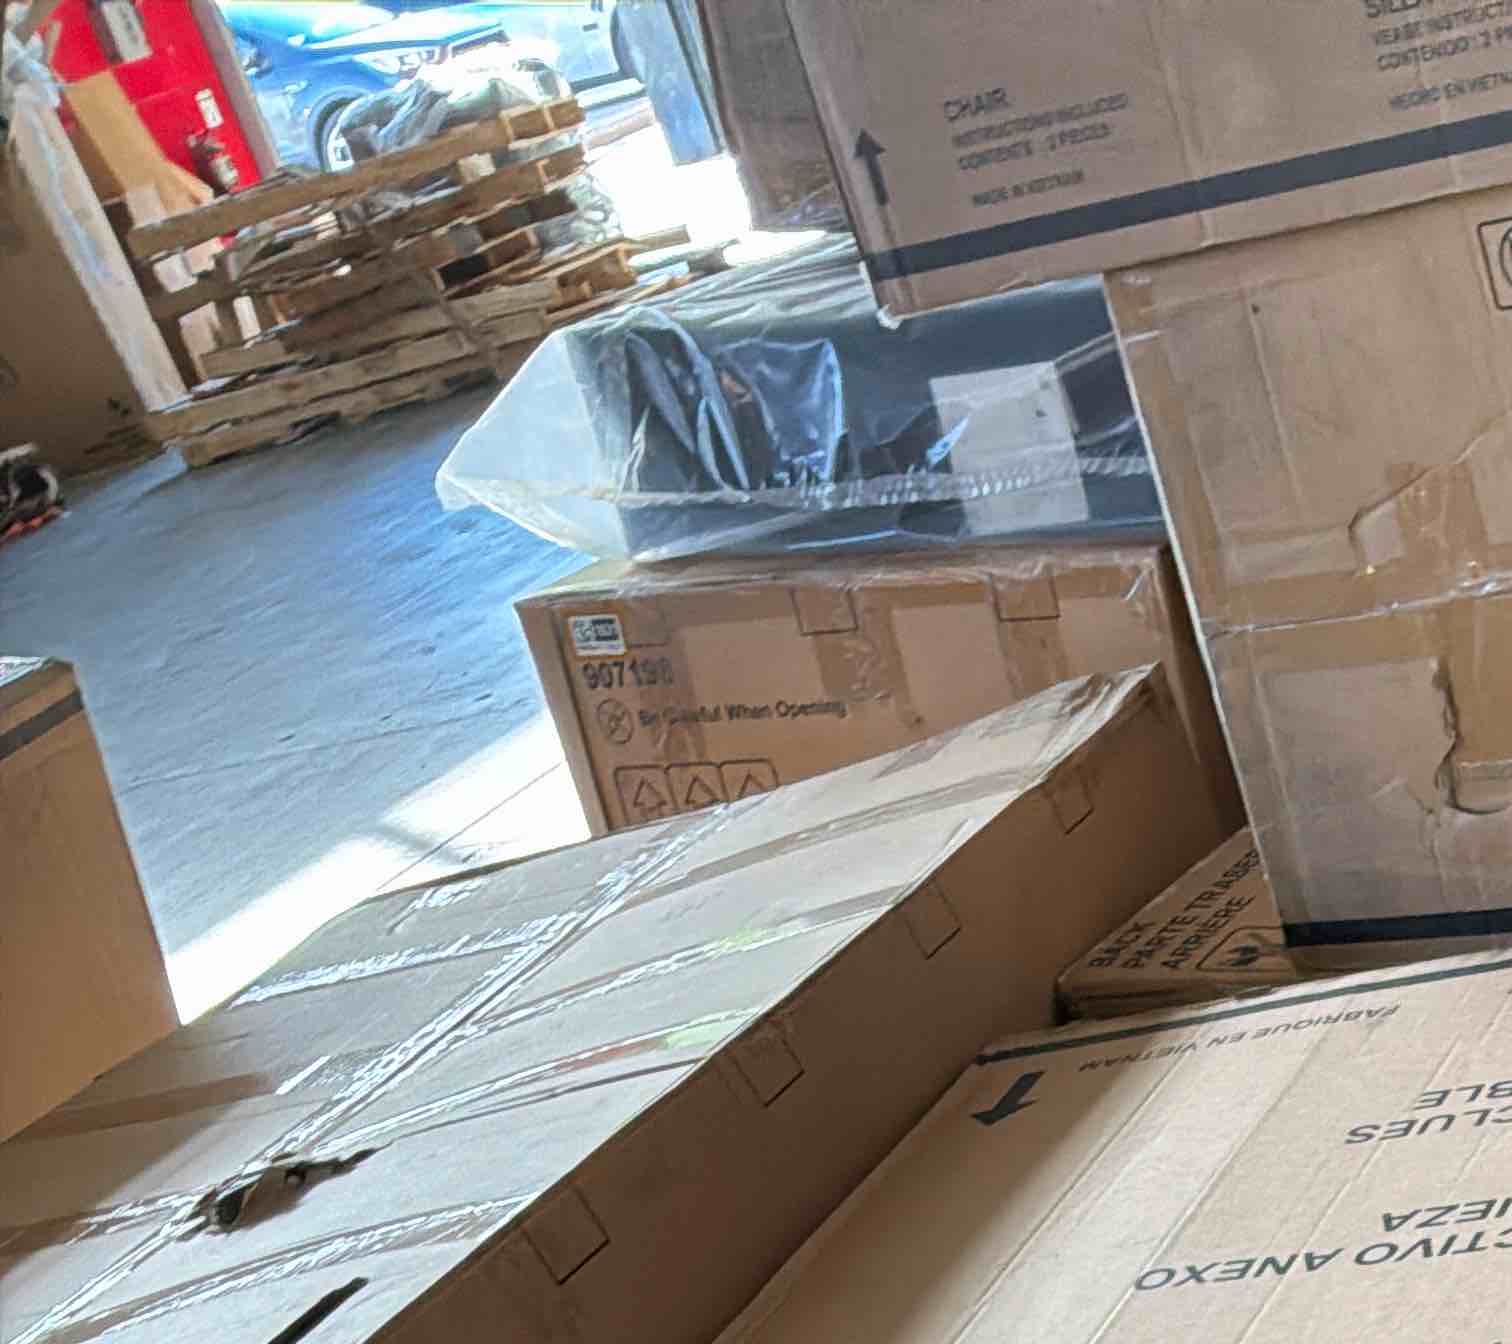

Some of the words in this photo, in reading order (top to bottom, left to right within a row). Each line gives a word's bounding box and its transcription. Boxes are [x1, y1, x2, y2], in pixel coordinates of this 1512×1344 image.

[943, 86, 1010, 122] CHAIR
[1252, 1004, 1400, 1039] FABRIQUE
[1078, 1041, 1198, 1073] VIETNAM
[1206, 1031, 1248, 1049] EN
[1133, 1247, 1345, 1292] ANEXO
